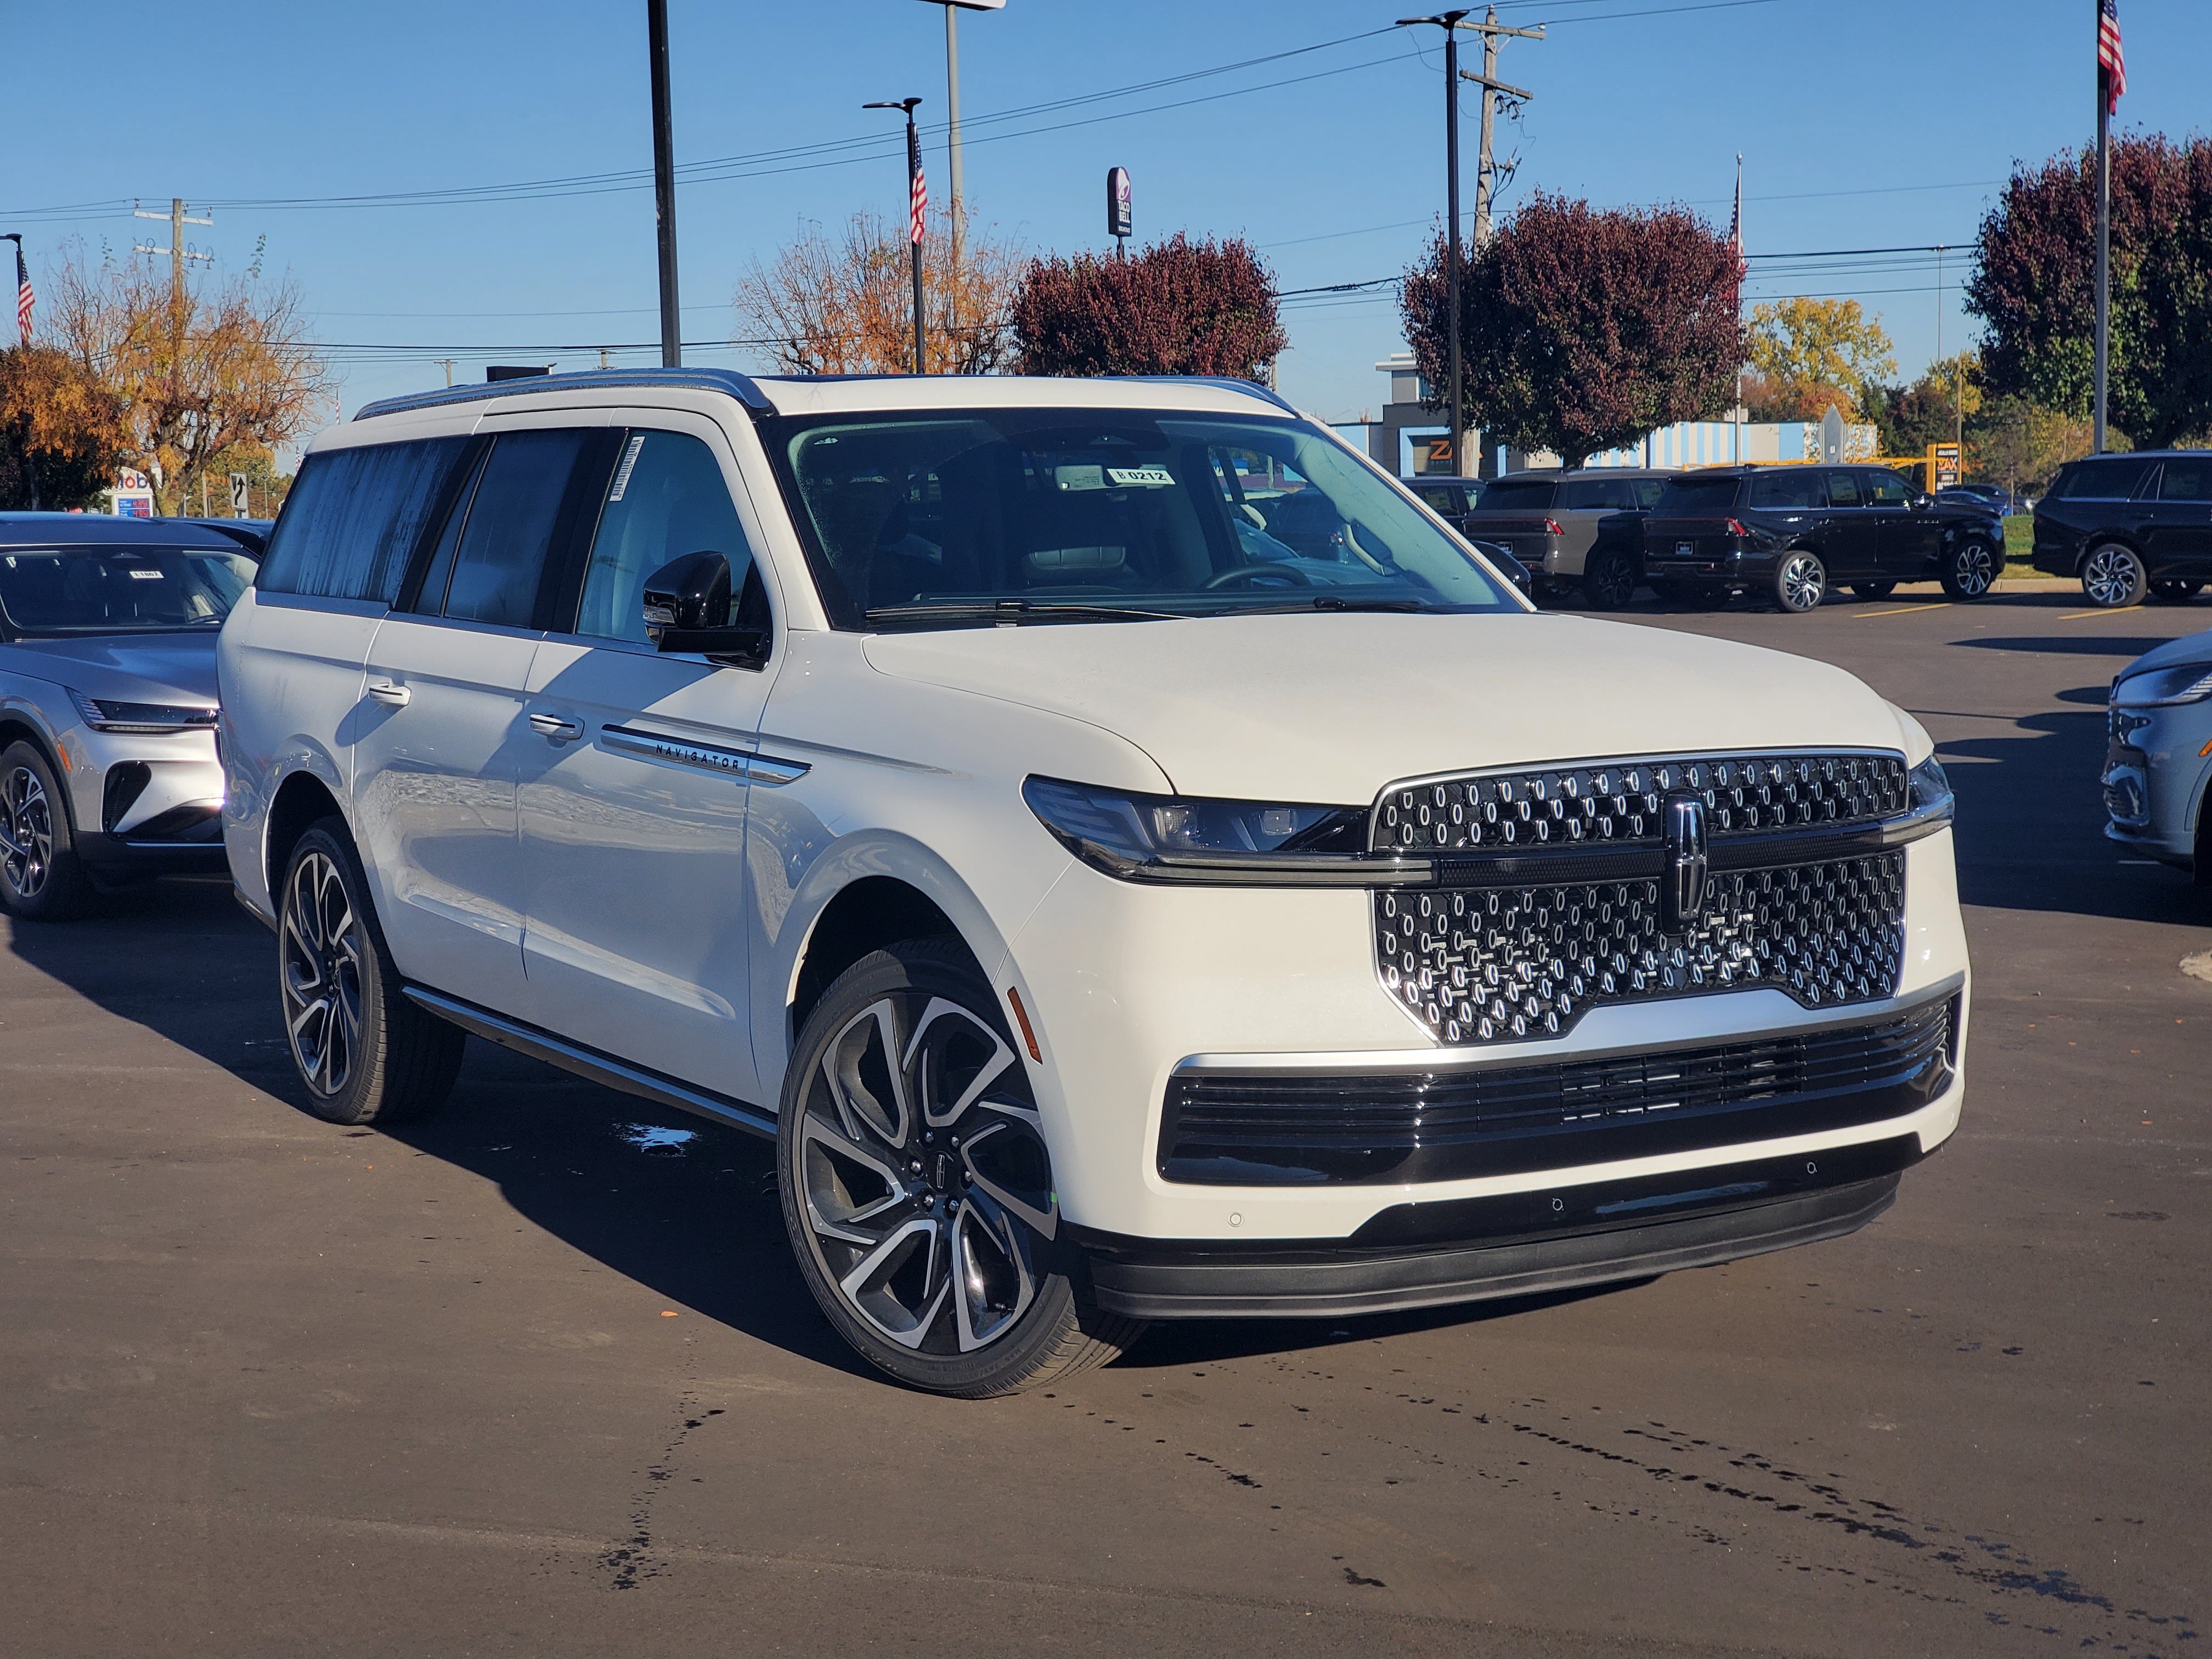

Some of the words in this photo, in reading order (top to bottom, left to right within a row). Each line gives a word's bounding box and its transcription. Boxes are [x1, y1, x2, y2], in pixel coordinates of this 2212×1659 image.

[1118, 200, 1130, 213] TACO
[1119, 211, 1131, 224] BELL
[1116, 471, 1126, 479] B
[1128, 472, 1167, 481] 0212
[656, 744, 738, 770] NAVIGATOR
